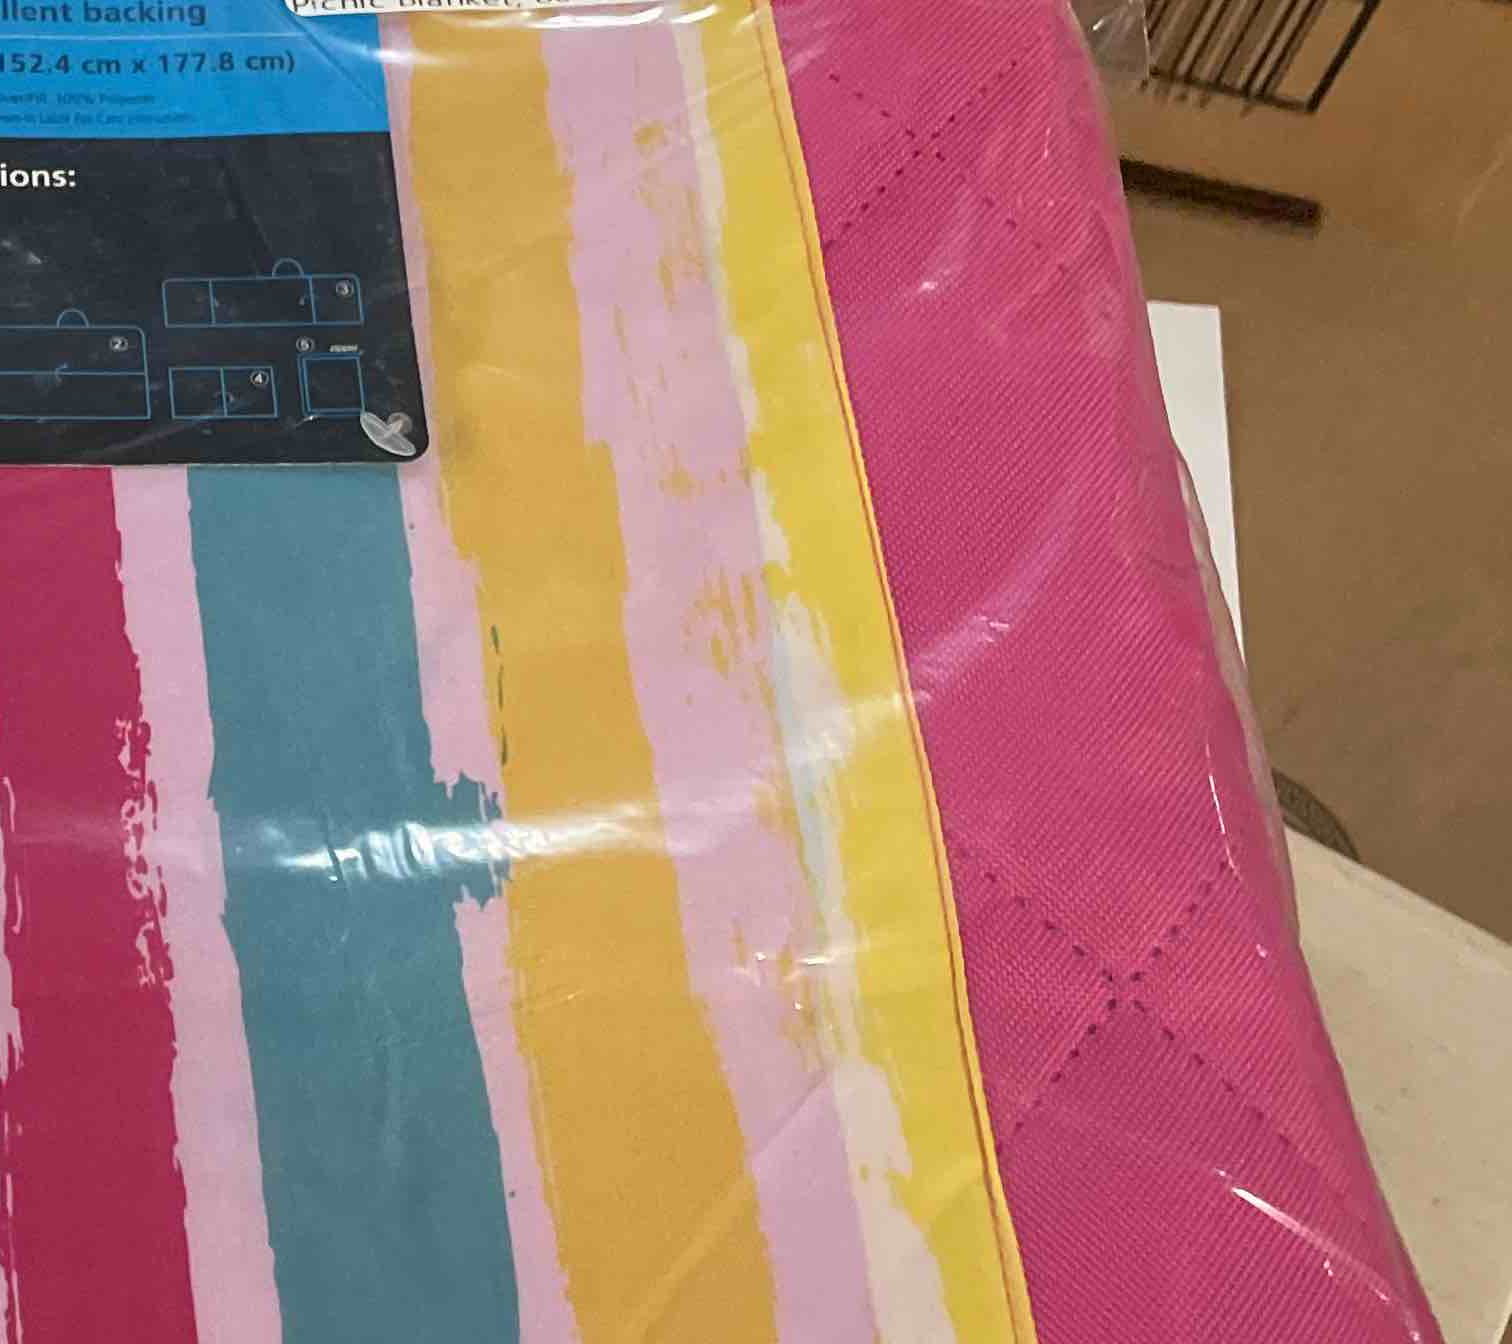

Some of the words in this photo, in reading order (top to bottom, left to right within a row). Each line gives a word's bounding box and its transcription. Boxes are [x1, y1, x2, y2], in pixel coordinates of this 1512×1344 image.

[83, 0, 208, 27] backing
[81, 58, 121, 76] cm
[132, 58, 149, 74] x
[160, 53, 235, 74] 177.8
[245, 50, 296, 75] cm)
